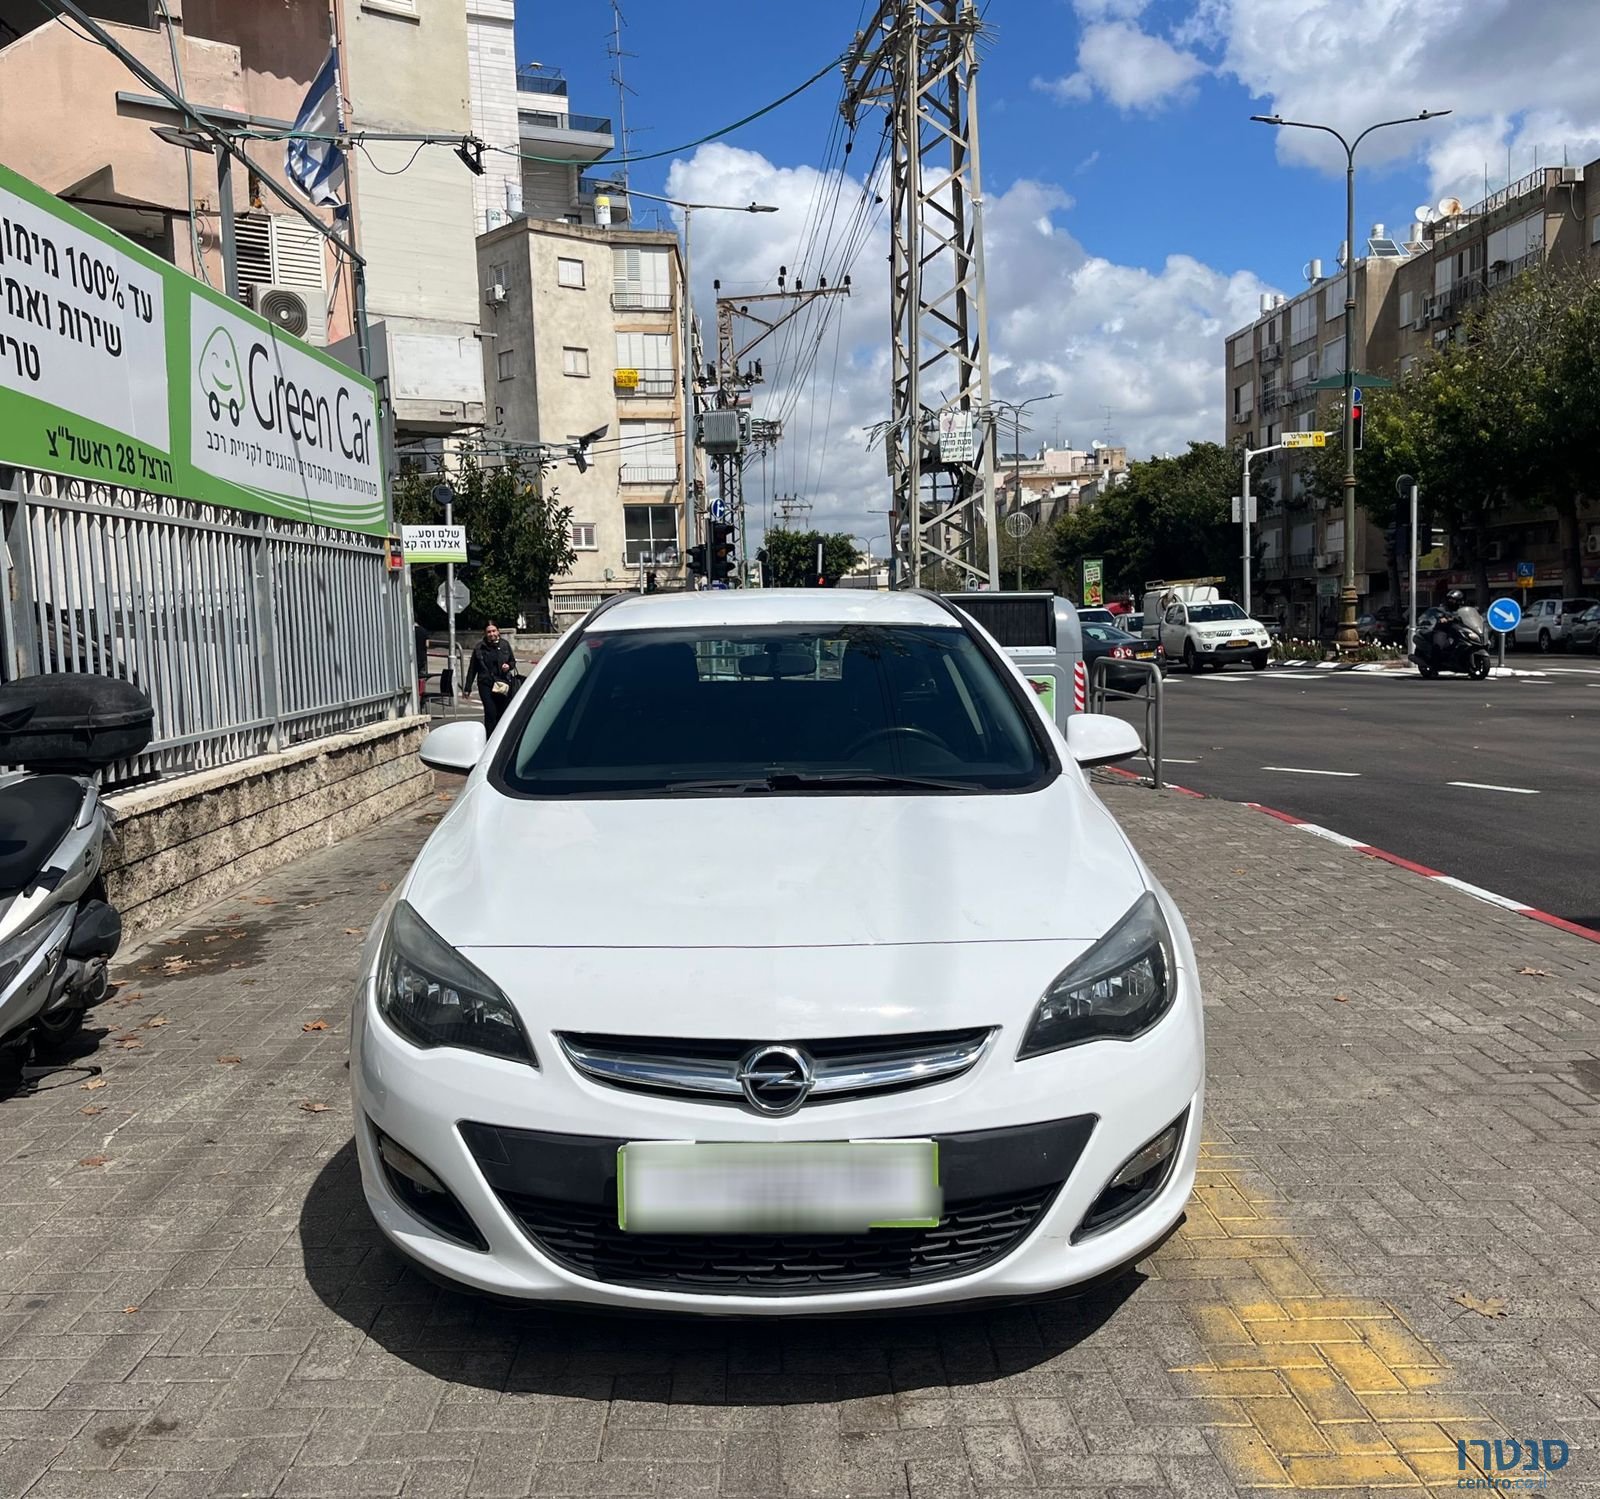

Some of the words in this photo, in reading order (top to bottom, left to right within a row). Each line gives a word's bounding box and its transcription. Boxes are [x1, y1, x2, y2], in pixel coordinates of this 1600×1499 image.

[66, 246, 125, 310] 100%
[0, 274, 52, 330] ואמ
[128, 283, 153, 323] עד
[57, 300, 122, 357] שירות
[249, 342, 333, 453] Green
[336, 386, 372, 466] Car
[46, 425, 113, 469] ראשל"צ
[206, 430, 227, 453] רכב
[230, 438, 262, 466] לקניית
[116, 443, 136, 475] 28
[138, 447, 173, 483] הרצל
[265, 449, 297, 473] והוגנים
[298, 460, 333, 485] מתקדמים
[334, 471, 353, 490] מימון
[420, 540, 431, 548] זה
[434, 539, 460, 549] אצלנו
[438, 528, 460, 538] שלם
